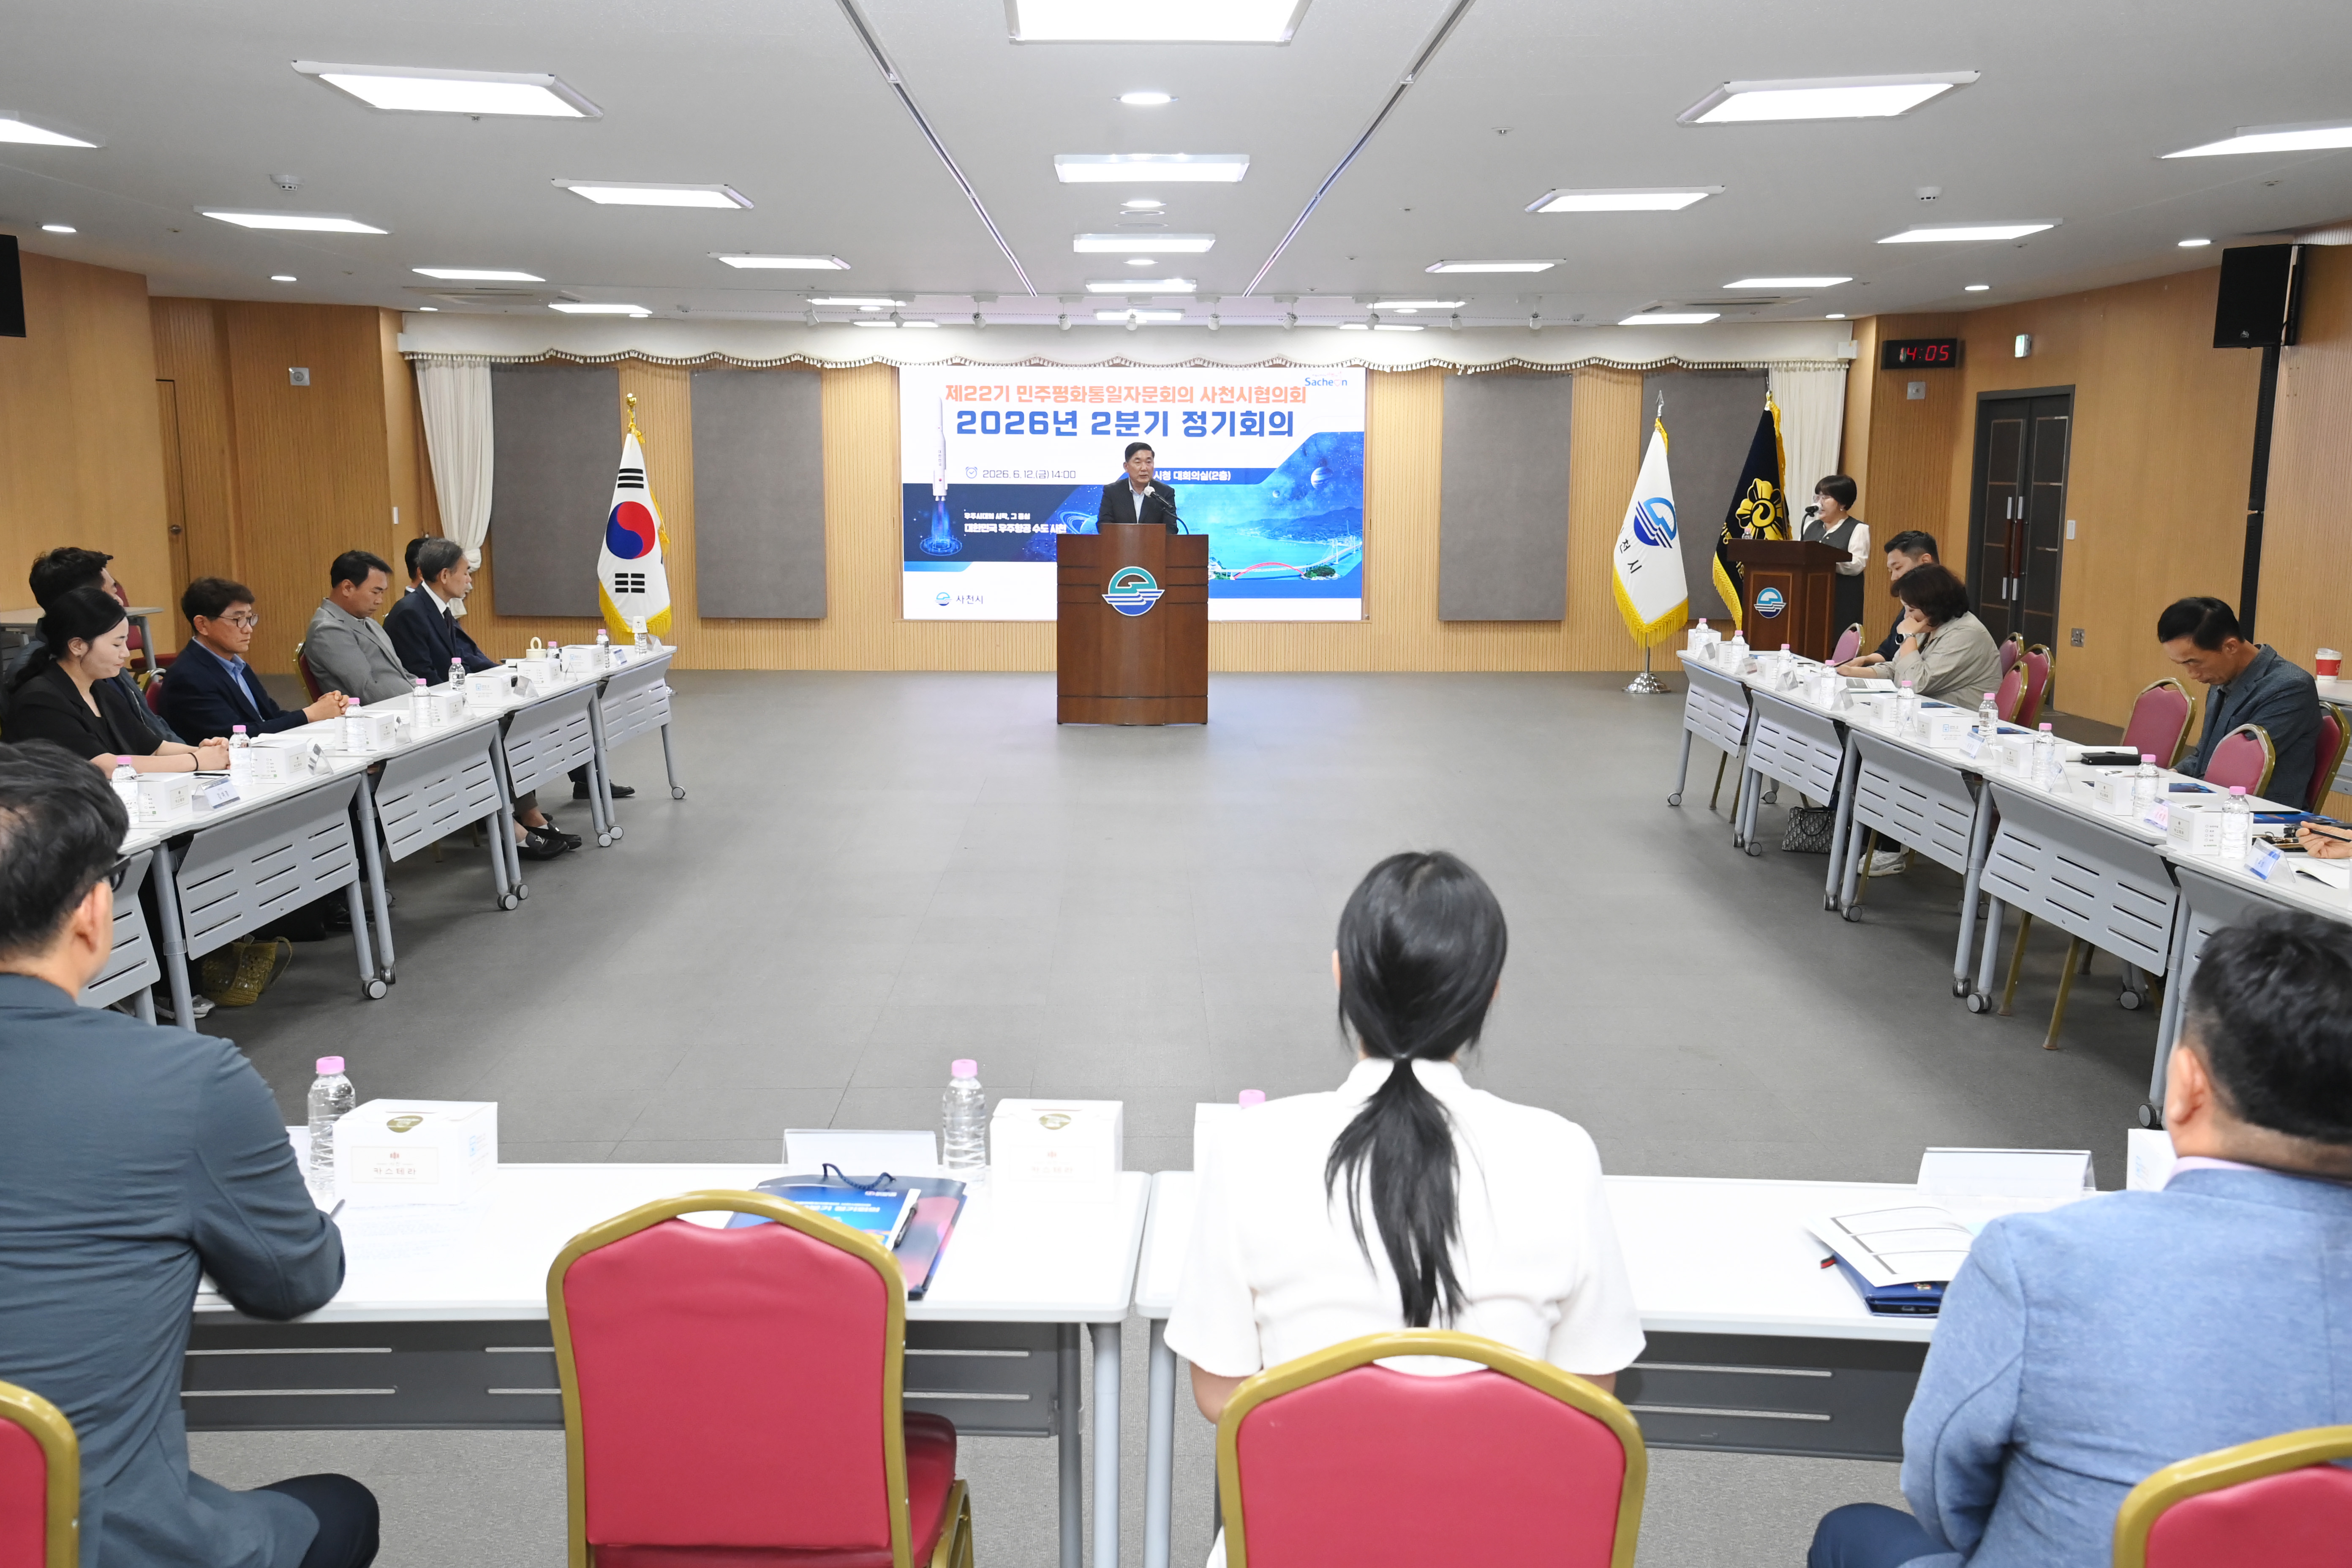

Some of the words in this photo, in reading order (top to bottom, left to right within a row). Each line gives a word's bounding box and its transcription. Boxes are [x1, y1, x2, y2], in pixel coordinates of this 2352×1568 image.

[1900, 345, 1949, 361] 14:05
[945, 385, 1010, 403] 제22기
[1017, 385, 1193, 403] 민주평화통일자문회의
[1200, 386, 1306, 404] 사천시협의회
[957, 410, 1077, 436] 2026년
[1091, 411, 1168, 437] 2분기
[1182, 410, 1293, 437] 정기회의
[983, 470, 1011, 479] 2026.
[1013, 470, 1021, 479] 6.
[1052, 470, 1076, 479] 14:00
[1173, 470, 1231, 481] 대회의실(2층)
[964, 523, 998, 533] 대한민국
[998, 523, 1032, 534] 우주항공
[1032, 523, 1049, 534] 수도
[956, 595, 983, 604] 사천시
[373, 1167, 416, 1175] 카스테라
